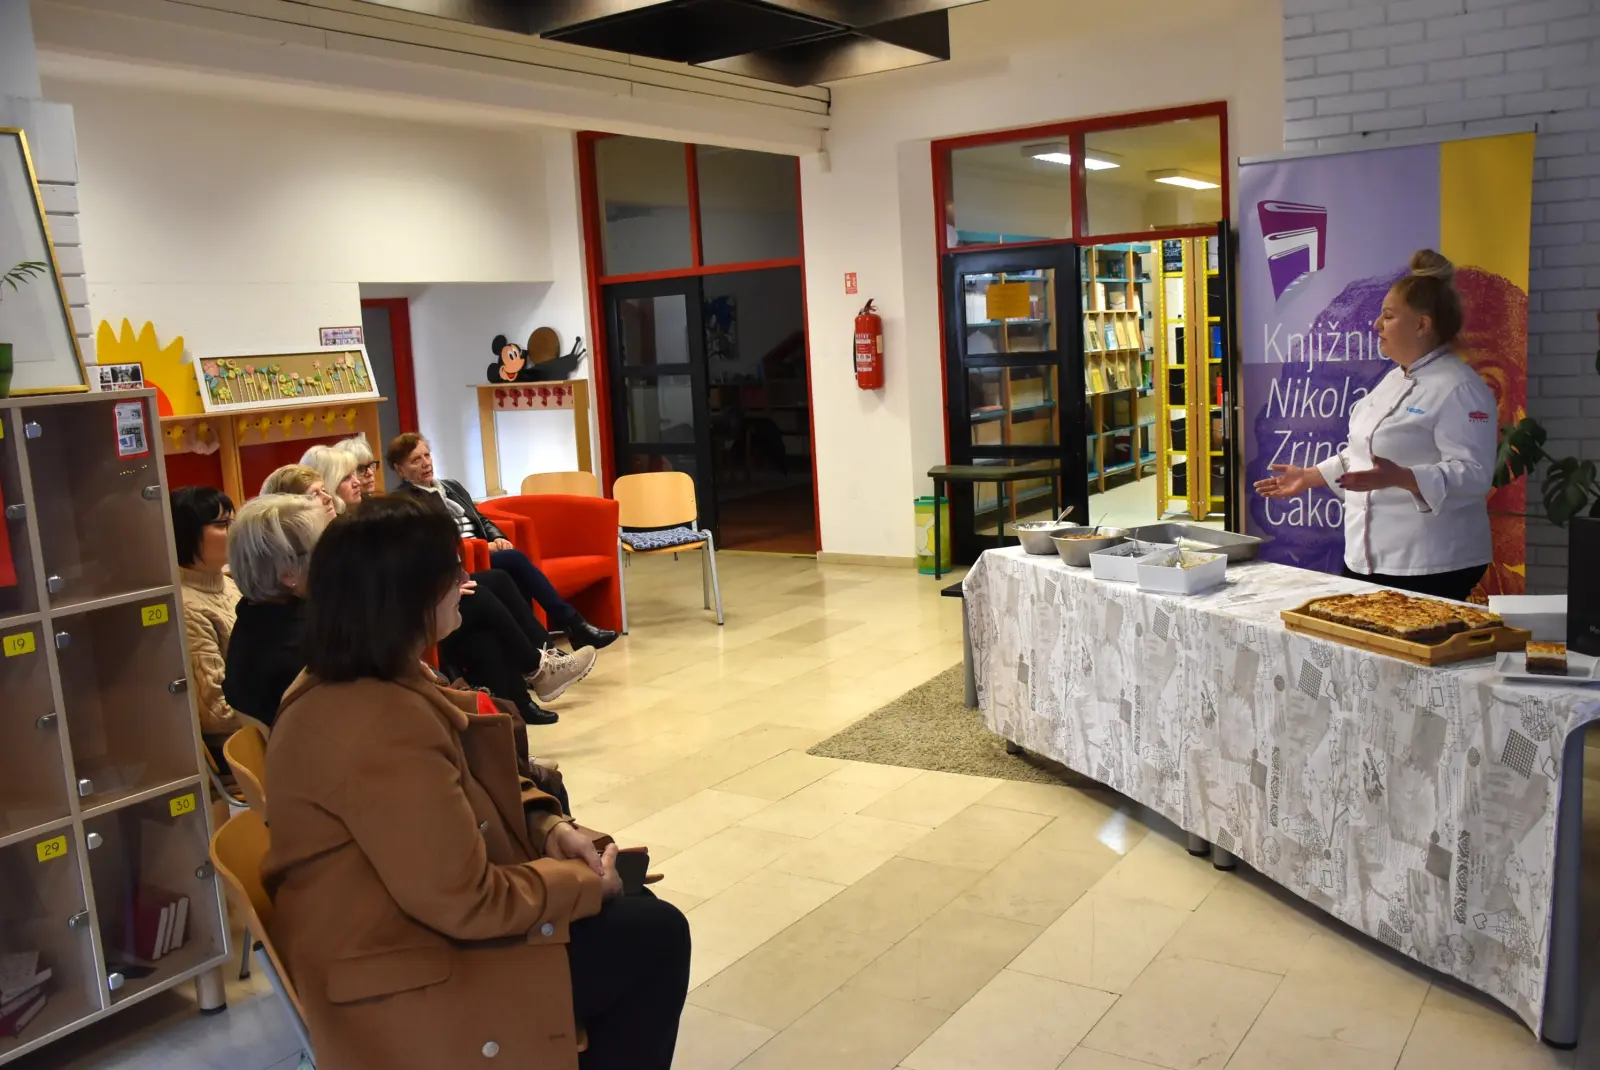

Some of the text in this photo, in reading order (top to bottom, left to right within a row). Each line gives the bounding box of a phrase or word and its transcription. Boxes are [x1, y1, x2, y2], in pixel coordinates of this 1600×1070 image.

[148, 609, 161, 621] 20
[12, 638, 25, 650] 19
[176, 799, 189, 811] 30
[44, 841, 60, 857] 29
